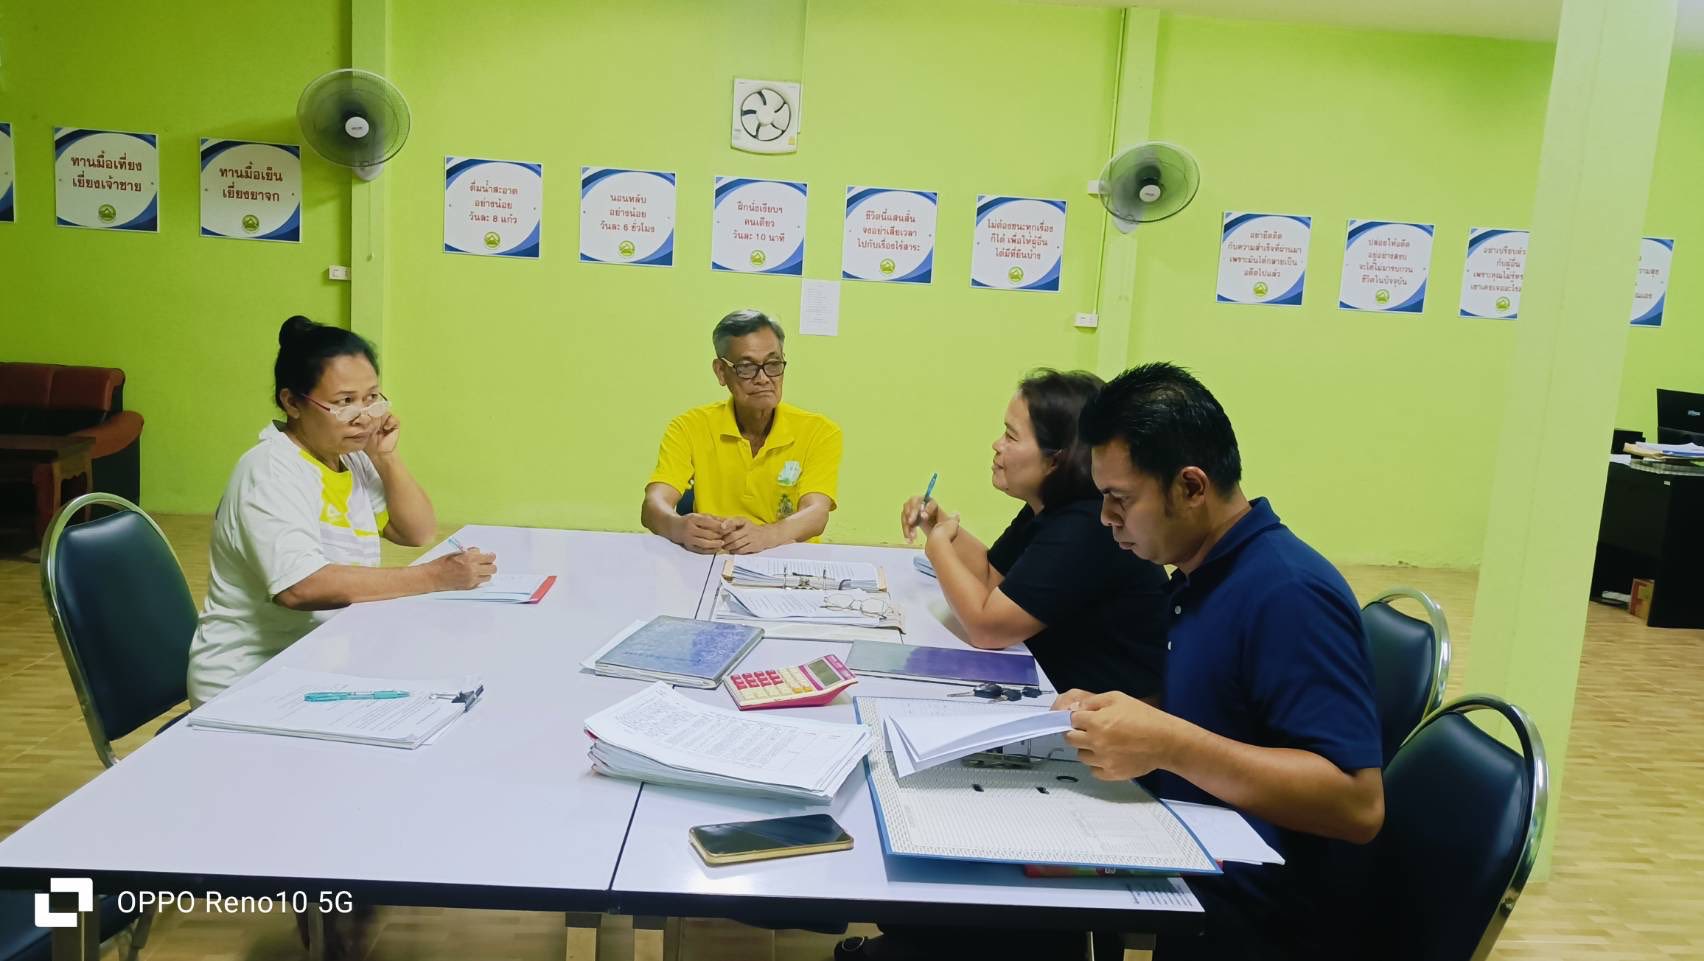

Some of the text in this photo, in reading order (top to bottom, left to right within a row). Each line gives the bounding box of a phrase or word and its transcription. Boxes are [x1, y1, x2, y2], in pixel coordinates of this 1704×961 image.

[71, 150, 142, 171] ทานมื้อเที่ยง
[219, 161, 283, 182] ทานมื้อเย็น
[72, 170, 142, 192] เยี่ยงเจ้าชาย
[222, 182, 280, 202] เยี่ยงยาจก
[474, 197, 513, 209] อย่างน้อย
[610, 194, 647, 204] นอนหลับ
[469, 211, 489, 222] วันละ
[501, 213, 518, 224] แก้ว
[609, 206, 647, 218] อย่างน้อย
[600, 220, 620, 230] วันละ
[744, 217, 775, 227] คนเดียว
[732, 229, 785, 242] วันละ 10 นาที
